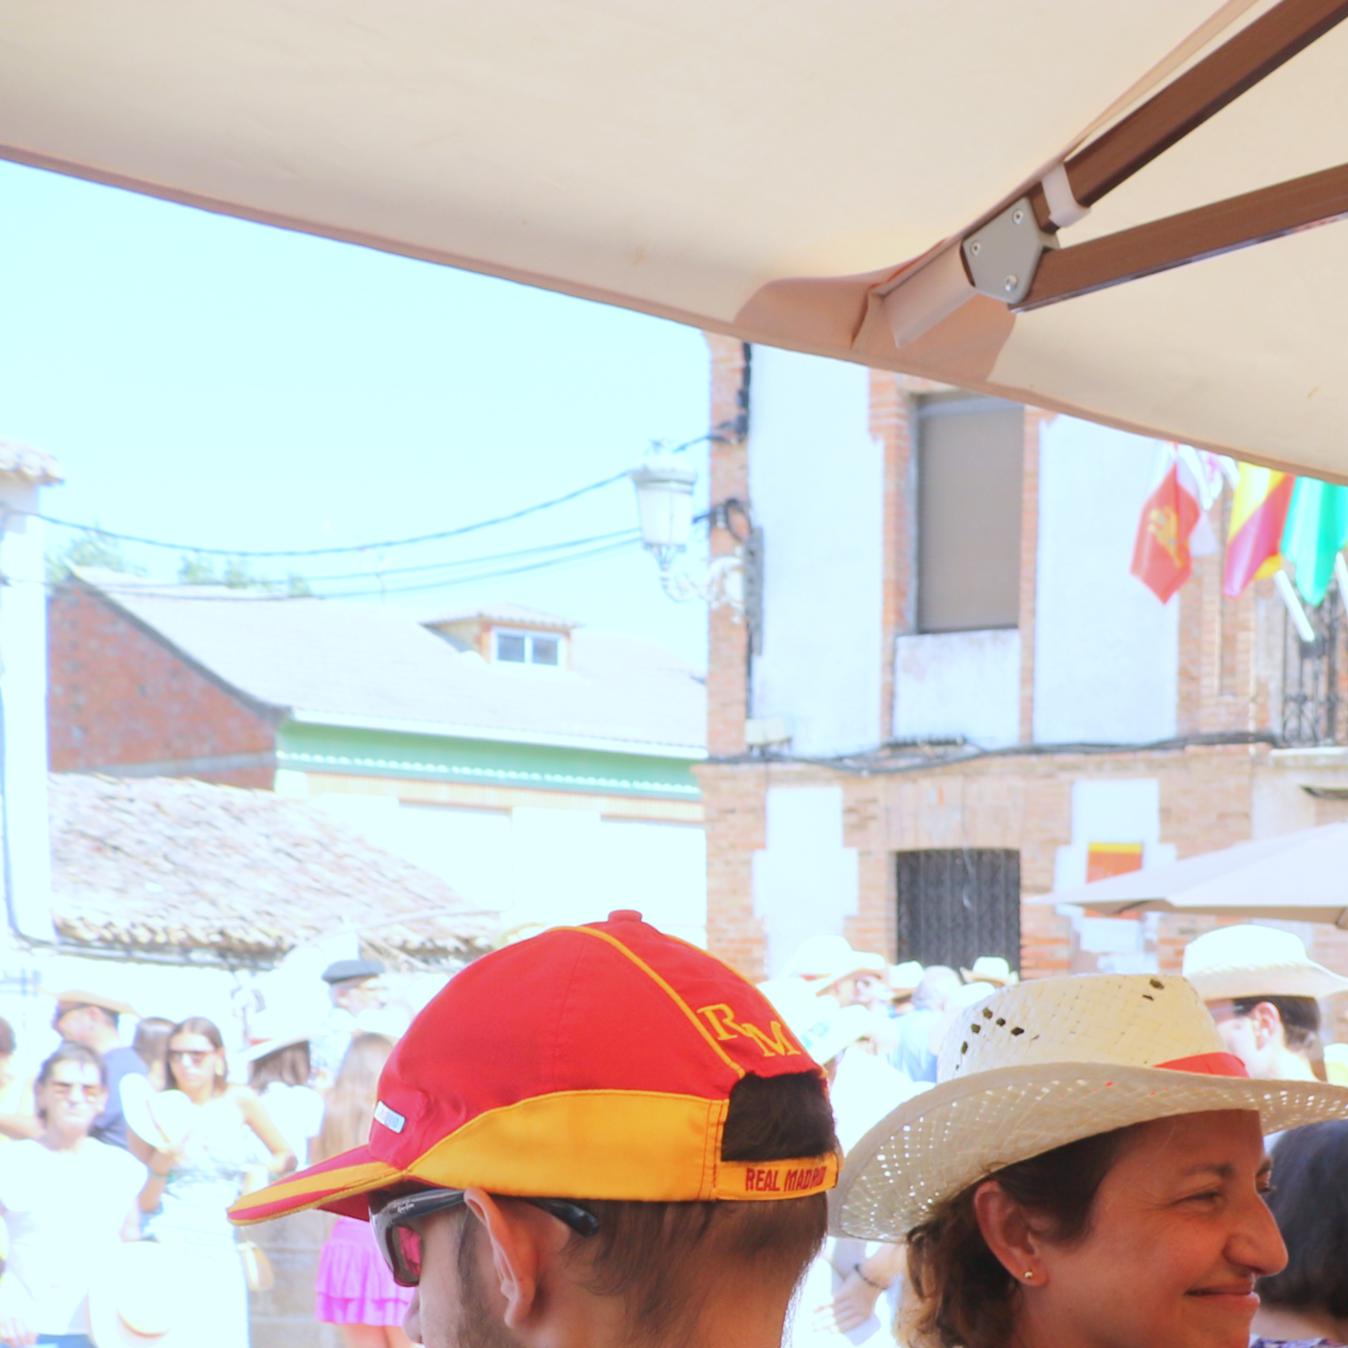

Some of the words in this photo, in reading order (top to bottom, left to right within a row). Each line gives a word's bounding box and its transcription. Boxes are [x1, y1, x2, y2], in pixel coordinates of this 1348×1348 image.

[697, 1003, 801, 1057] RM
[745, 1167, 780, 1192] REAL
[784, 1166, 827, 1192] MADRID
